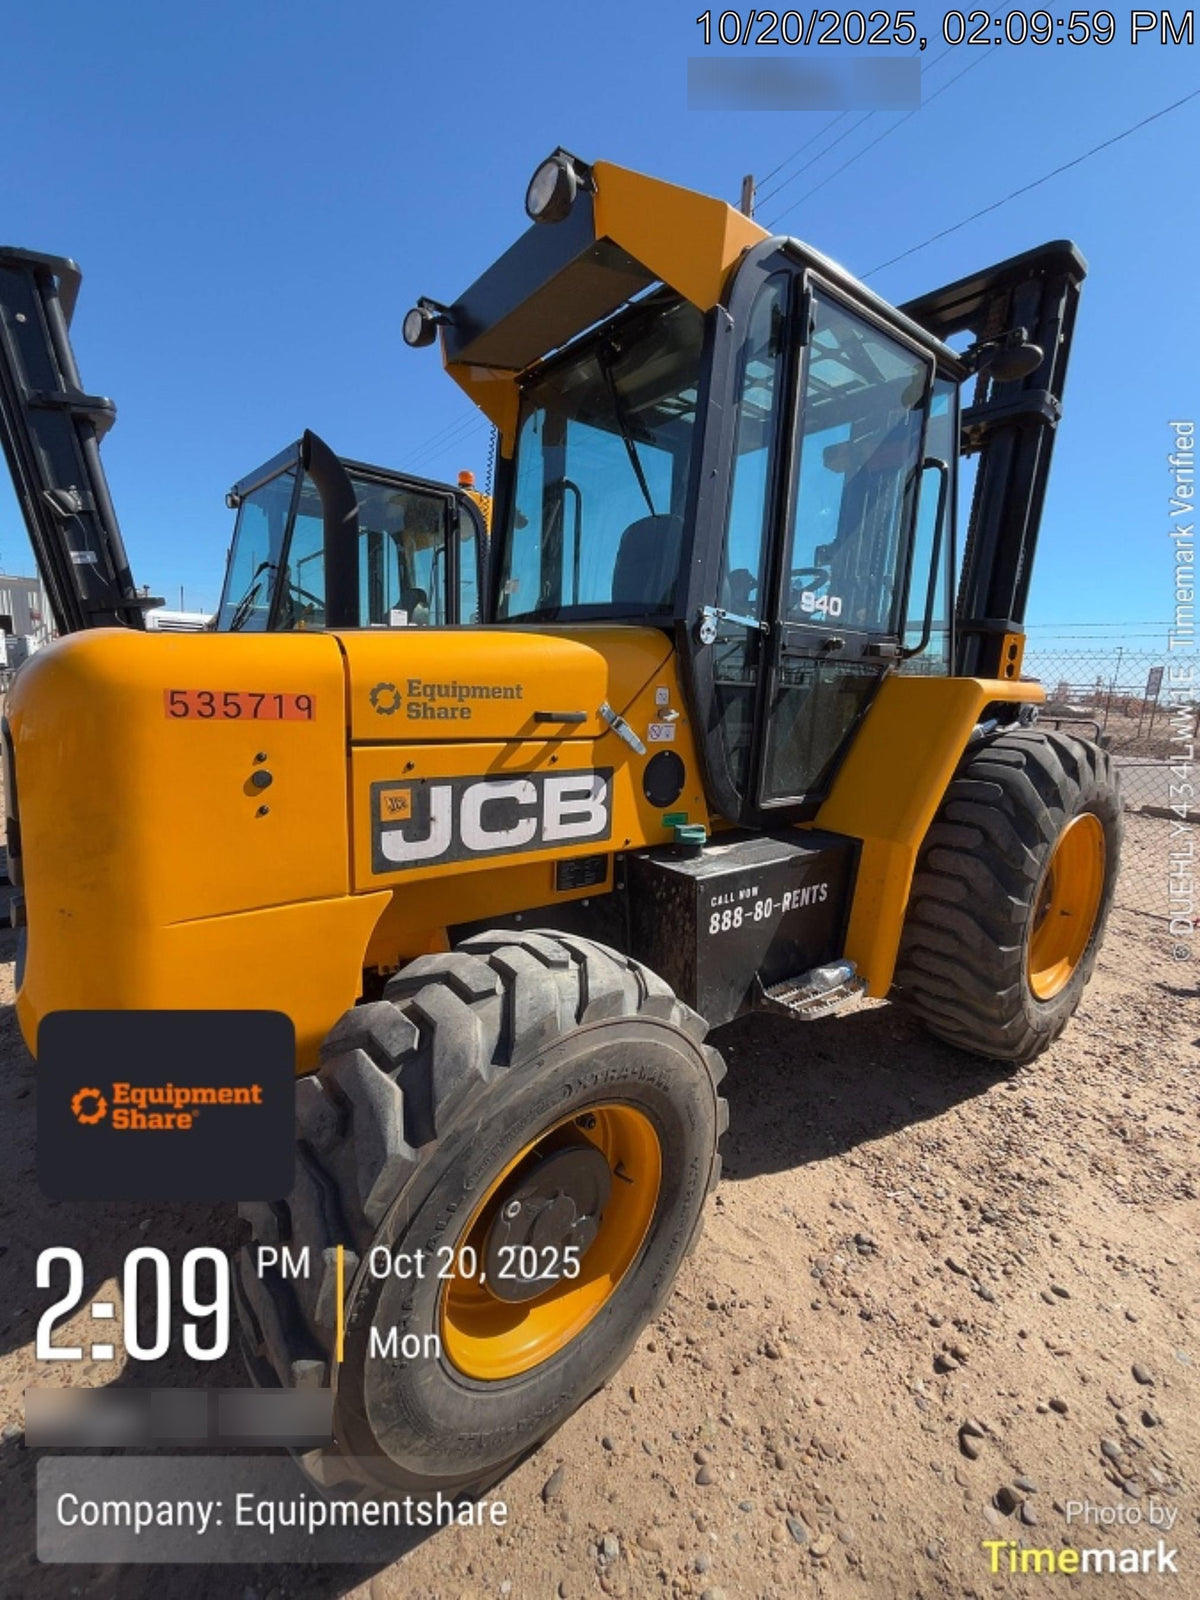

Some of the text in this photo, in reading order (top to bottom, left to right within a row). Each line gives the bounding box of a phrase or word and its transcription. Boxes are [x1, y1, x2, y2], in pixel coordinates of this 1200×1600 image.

[801, 591, 842, 616] 940
[406, 679, 523, 702] Equipment
[169, 690, 312, 719] 535719
[406, 702, 472, 720] Share
[381, 774, 608, 862] JCB
[709, 883, 828, 934] 888-80-RENTS
[710, 886, 759, 907] CALL NOW
